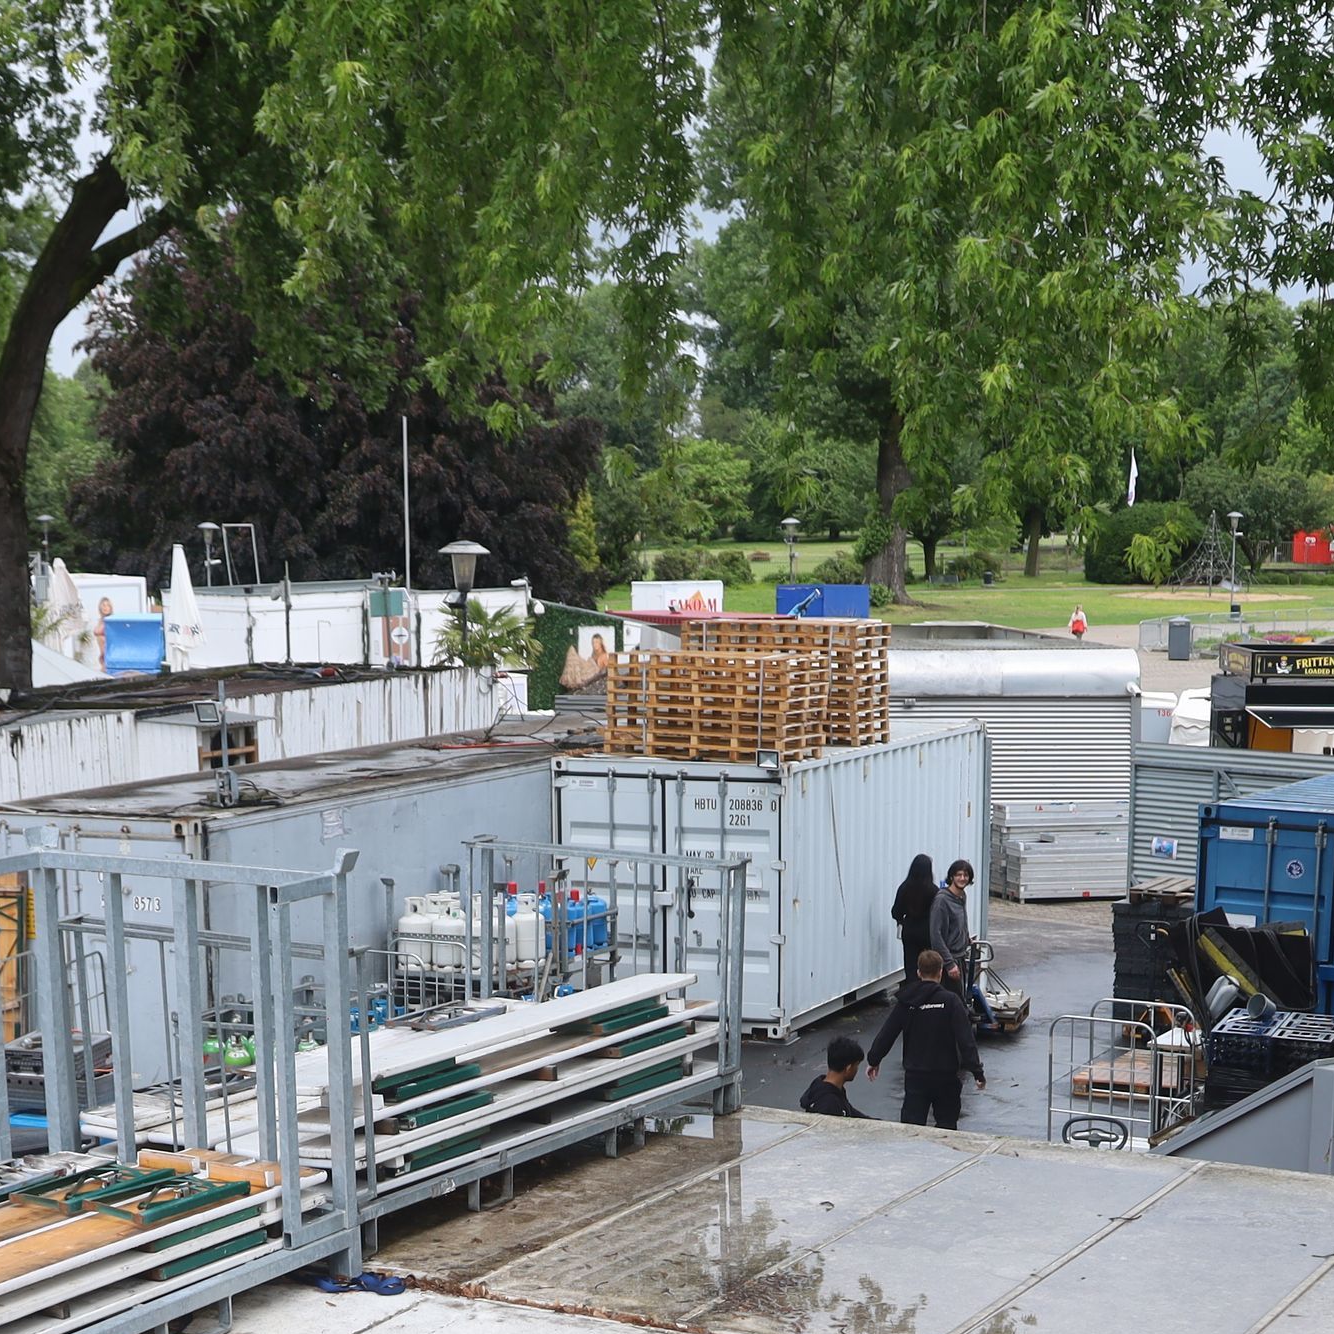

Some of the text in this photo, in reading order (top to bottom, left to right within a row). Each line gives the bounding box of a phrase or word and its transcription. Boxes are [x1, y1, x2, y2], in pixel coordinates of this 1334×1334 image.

[694, 798, 777, 812] HBTU 208836 0
[729, 814, 751, 826] 22G1
